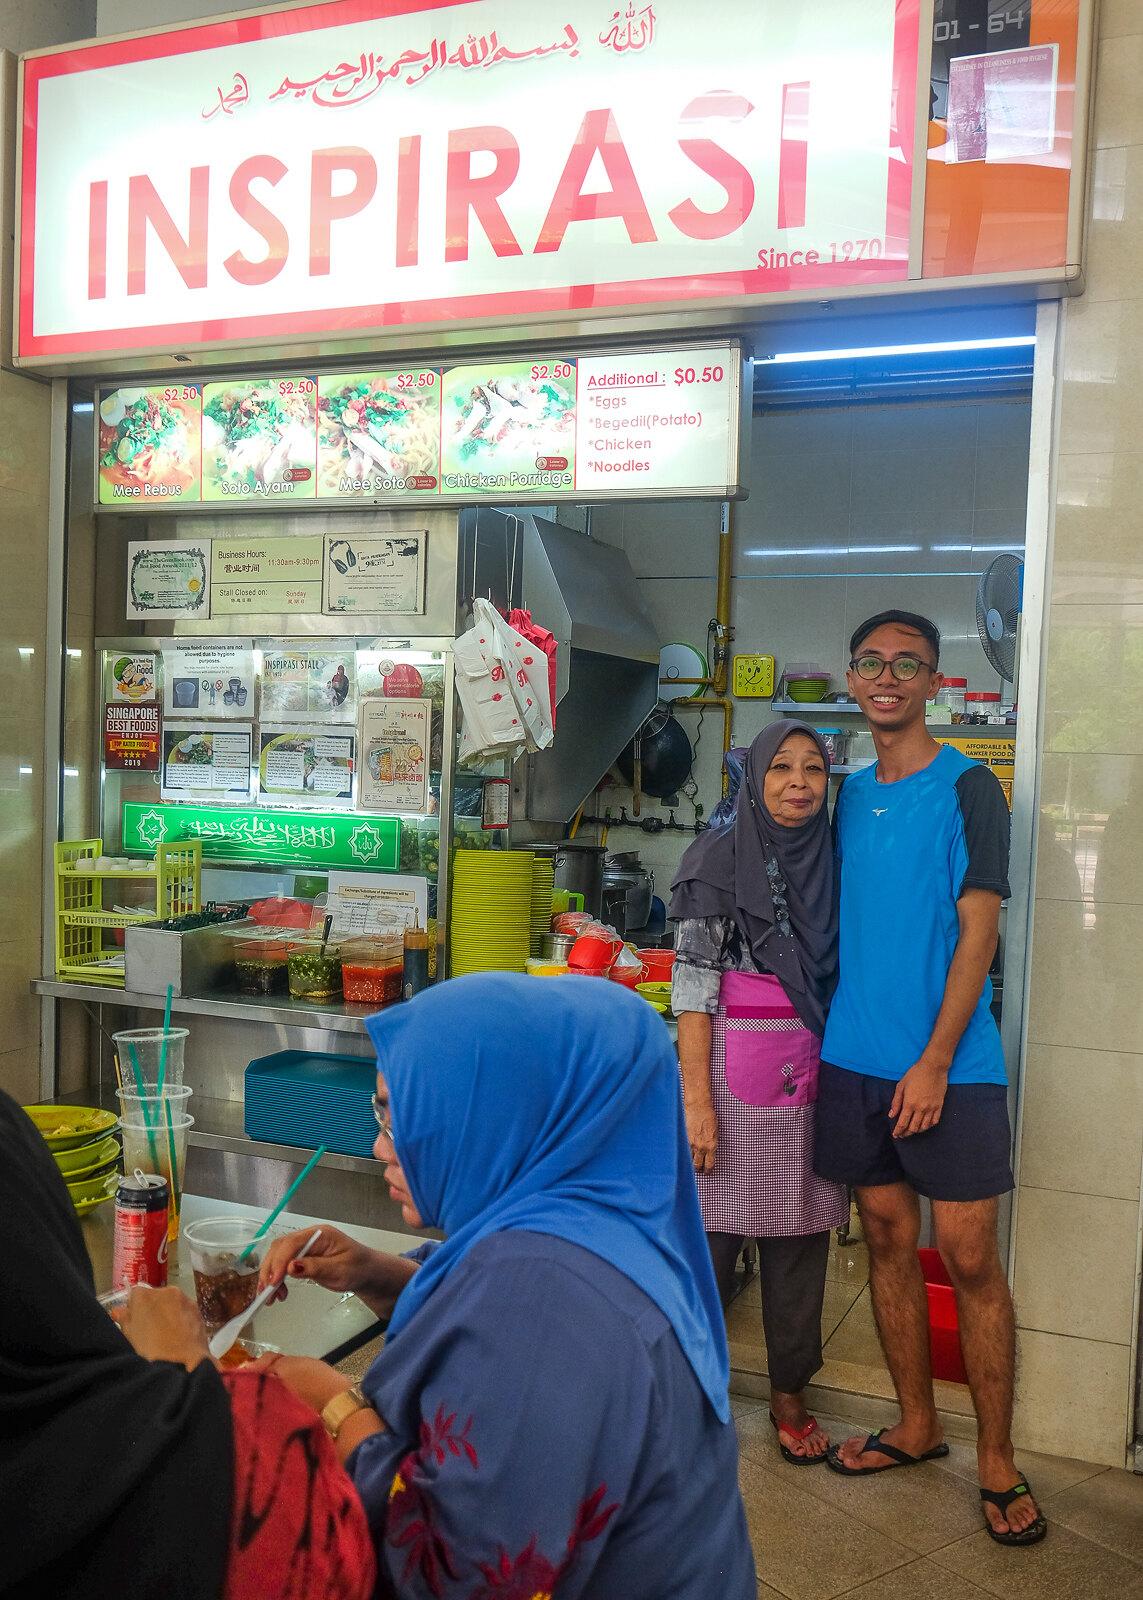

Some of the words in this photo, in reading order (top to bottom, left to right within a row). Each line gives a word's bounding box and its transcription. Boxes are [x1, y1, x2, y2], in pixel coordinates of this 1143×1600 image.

[933, 20, 960, 41] 01
[987, 10, 1024, 33] 64
[88, 83, 809, 300] INSPIRASI
[757, 248, 819, 269] Since
[829, 239, 881, 262] 1970
[397, 373, 435, 389] $2.50
[531, 364, 571, 382] $2.50
[588, 371, 658, 387] Additional
[674, 366, 724, 387] $0.50
[164, 387, 197, 401] $2.50
[279, 381, 314, 397] $2.50
[339, 477, 371, 492] Mee
[375, 476, 406, 491] Soto
[445, 473, 507, 488] Chicken
[510, 471, 572, 488] Porridge
[113, 484, 141, 497] Mee
[144, 483, 182, 497] Rebus
[221, 481, 250, 495] Soto
[253, 480, 294, 496] Ayam
[218, 551, 246, 559] Business
[246, 550, 267, 558] Hours:
[235, 588, 256, 596] Closed
[286, 590, 306, 598] Sunday
[136, 664, 154, 674] Good
[265, 660, 298, 670] INSPIRASI
[107, 707, 158, 720] SINGAPORE
[108, 721, 128, 731] BEST
[130, 721, 156, 731] FOODS
